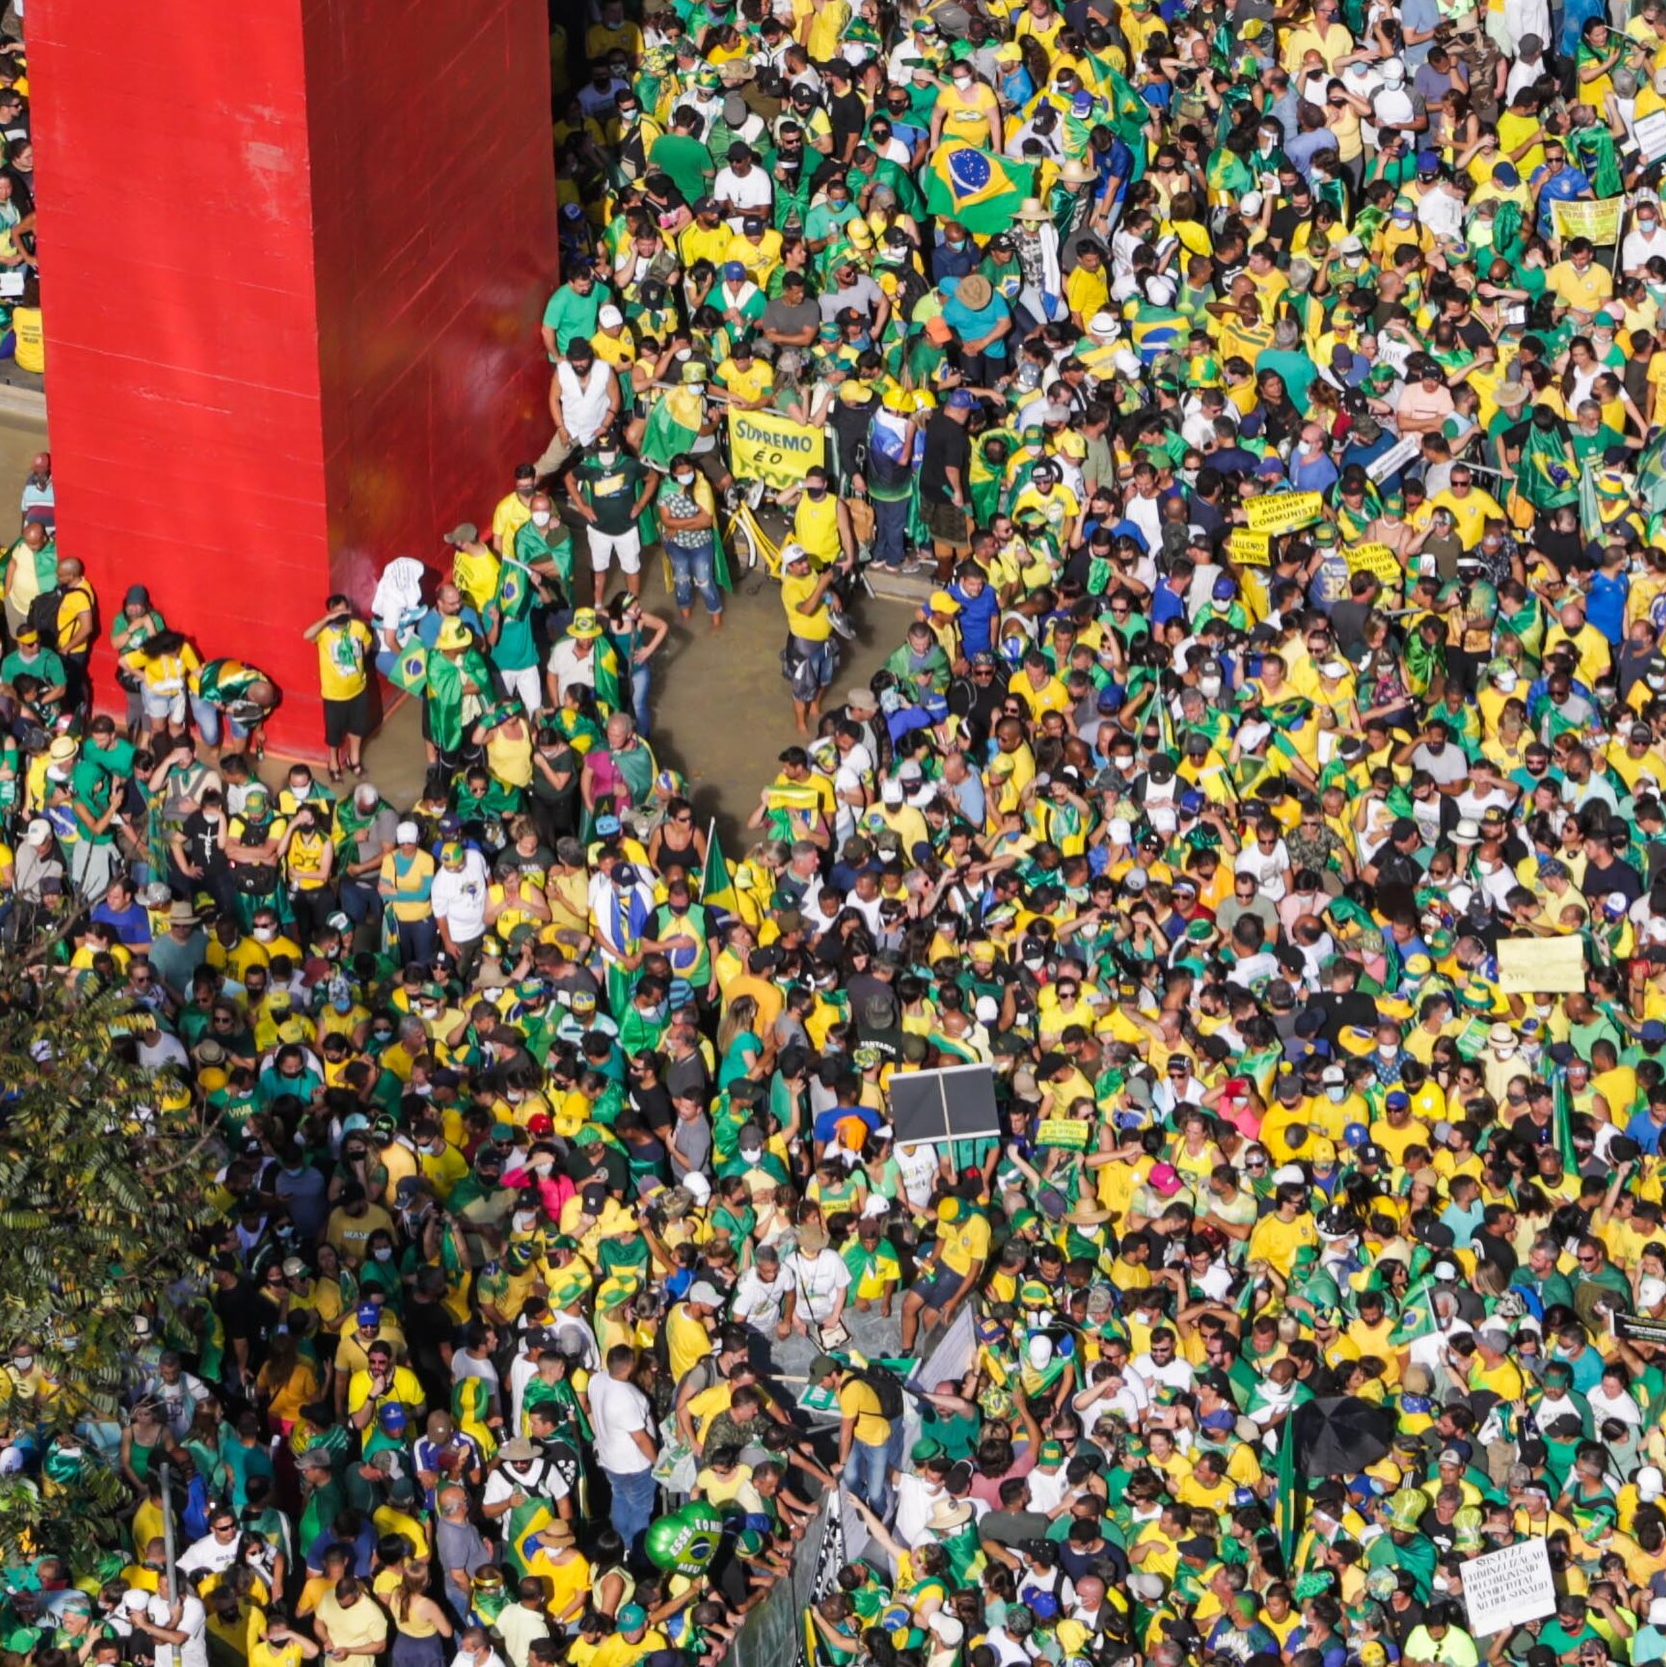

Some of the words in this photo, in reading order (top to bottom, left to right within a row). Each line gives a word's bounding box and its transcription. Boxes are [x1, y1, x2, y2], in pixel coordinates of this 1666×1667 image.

[736, 420, 813, 453] SUPREMO
[753, 446, 767, 462] É
[770, 453, 783, 465] O
[1262, 498, 1306, 516] AGAINST
[669, 1526, 692, 1557] ESSE
